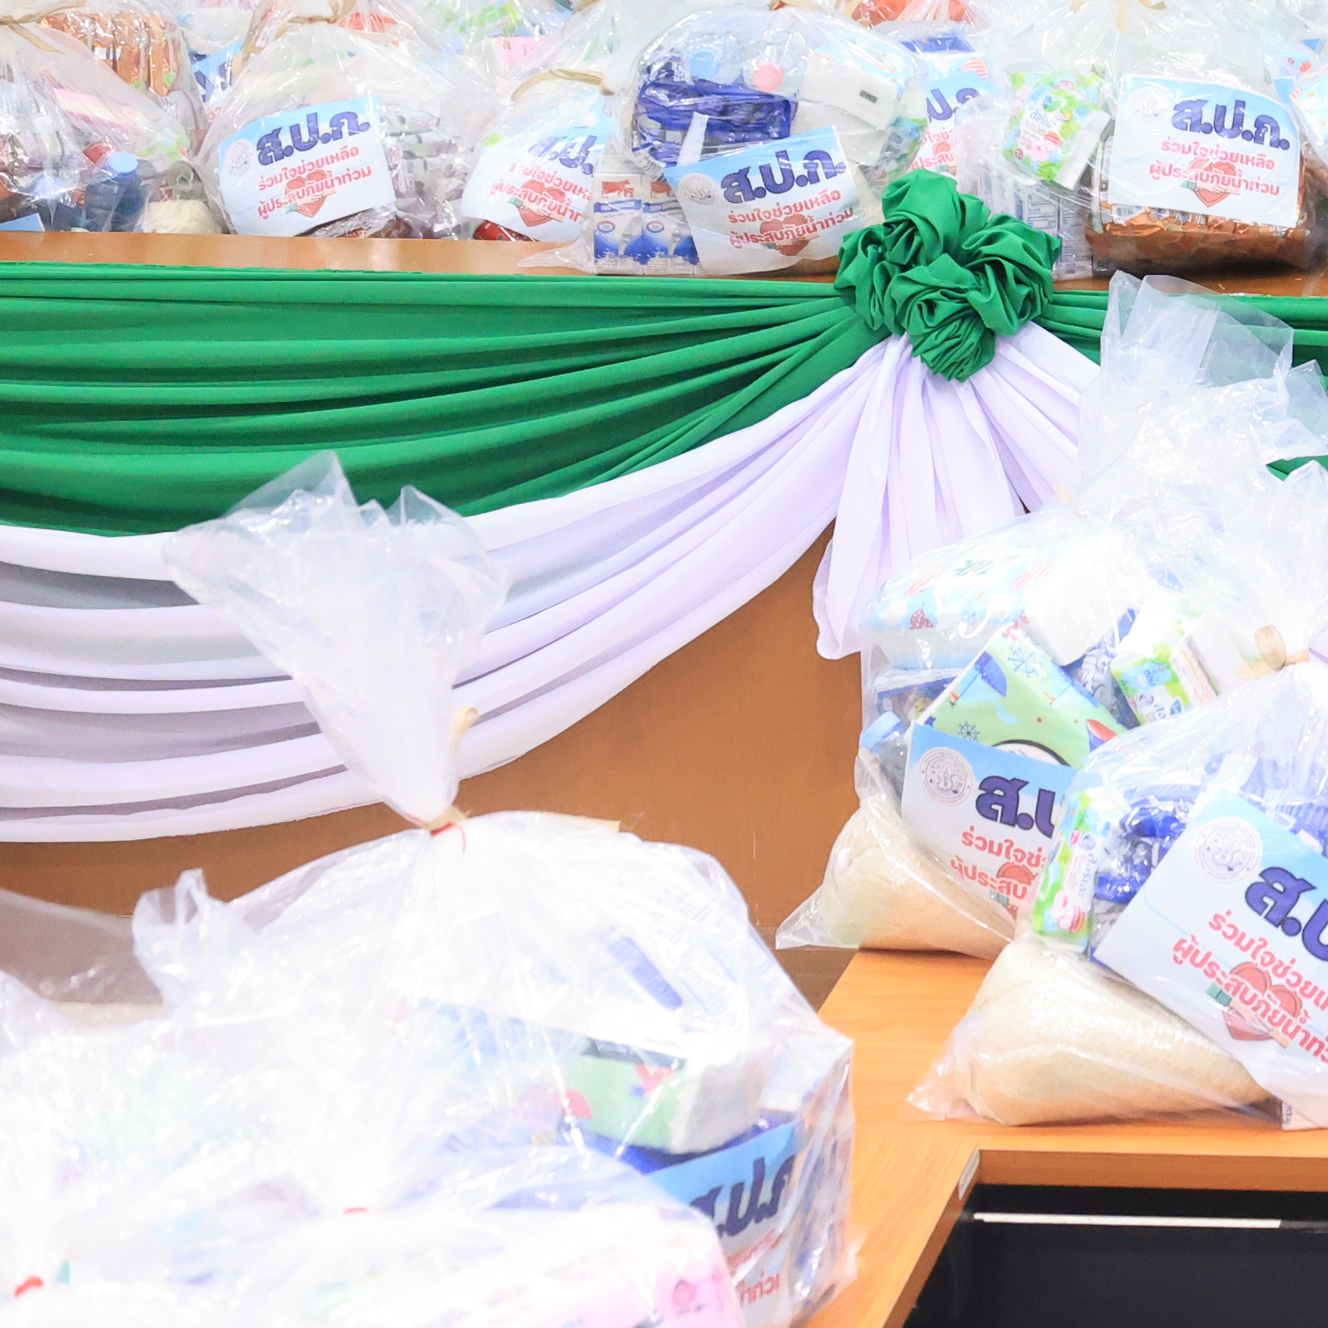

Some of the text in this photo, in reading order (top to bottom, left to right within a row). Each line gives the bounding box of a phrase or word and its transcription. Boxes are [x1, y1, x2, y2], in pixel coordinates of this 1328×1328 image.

[256, 111, 371, 166] ส.ป.ก.
[1171, 98, 1291, 151] ส.ป.ก.
[258, 144, 360, 192] ร่วมใจช่วยเหลือ
[721, 149, 847, 204] ส.ป.ก.
[1161, 136, 1276, 170] ร่วมใจช่วยเหลือ
[257, 165, 372, 220] ผู้ประสบภัยน้ำท่วม
[728, 188, 842, 224] ร่วมใจช่วยเหลือ
[730, 206, 854, 250] ผู้ประสบภัยน้ำท่วม
